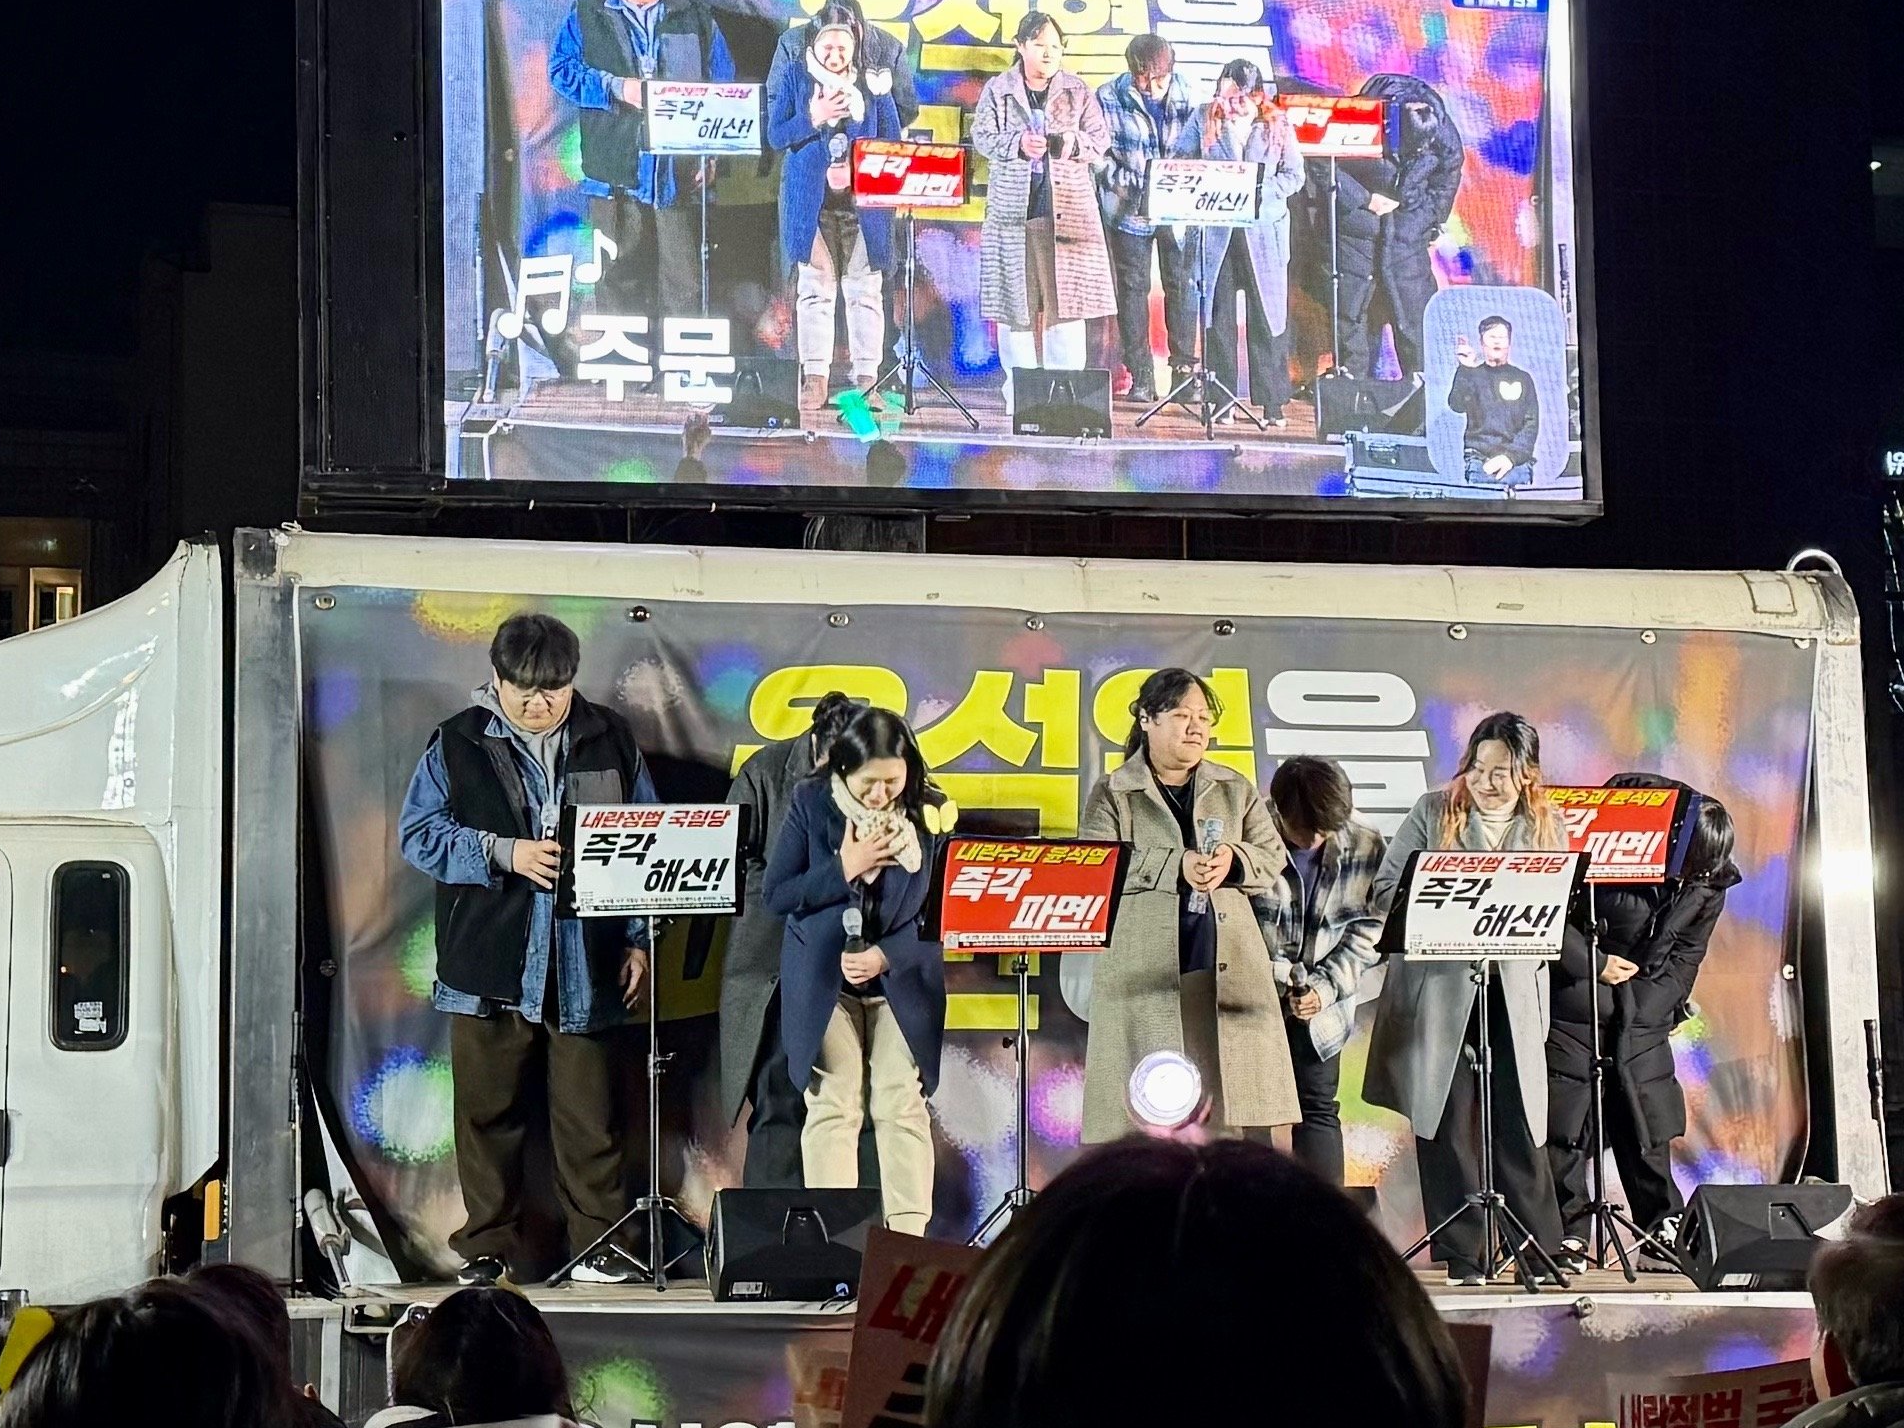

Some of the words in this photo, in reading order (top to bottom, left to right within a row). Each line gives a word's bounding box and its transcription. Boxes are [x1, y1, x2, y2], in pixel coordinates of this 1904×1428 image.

[577, 315, 736, 404] 주문
[1545, 788, 1609, 806] 란수괴
[581, 810, 665, 829] 내란정범
[667, 809, 732, 829] 국힘당
[581, 832, 658, 867] 즉각
[953, 842, 1044, 864] 내란수괴
[1042, 845, 1114, 866] 윤석열
[1420, 855, 1506, 874] 내란정범
[1506, 856, 1570, 874] 국힘당
[644, 858, 731, 893] 해산!
[948, 865, 1033, 903] 즉각
[1415, 877, 1494, 910] 즉각
[1009, 894, 1107, 932] 파면!
[1472, 904, 1562, 938] 해산!
